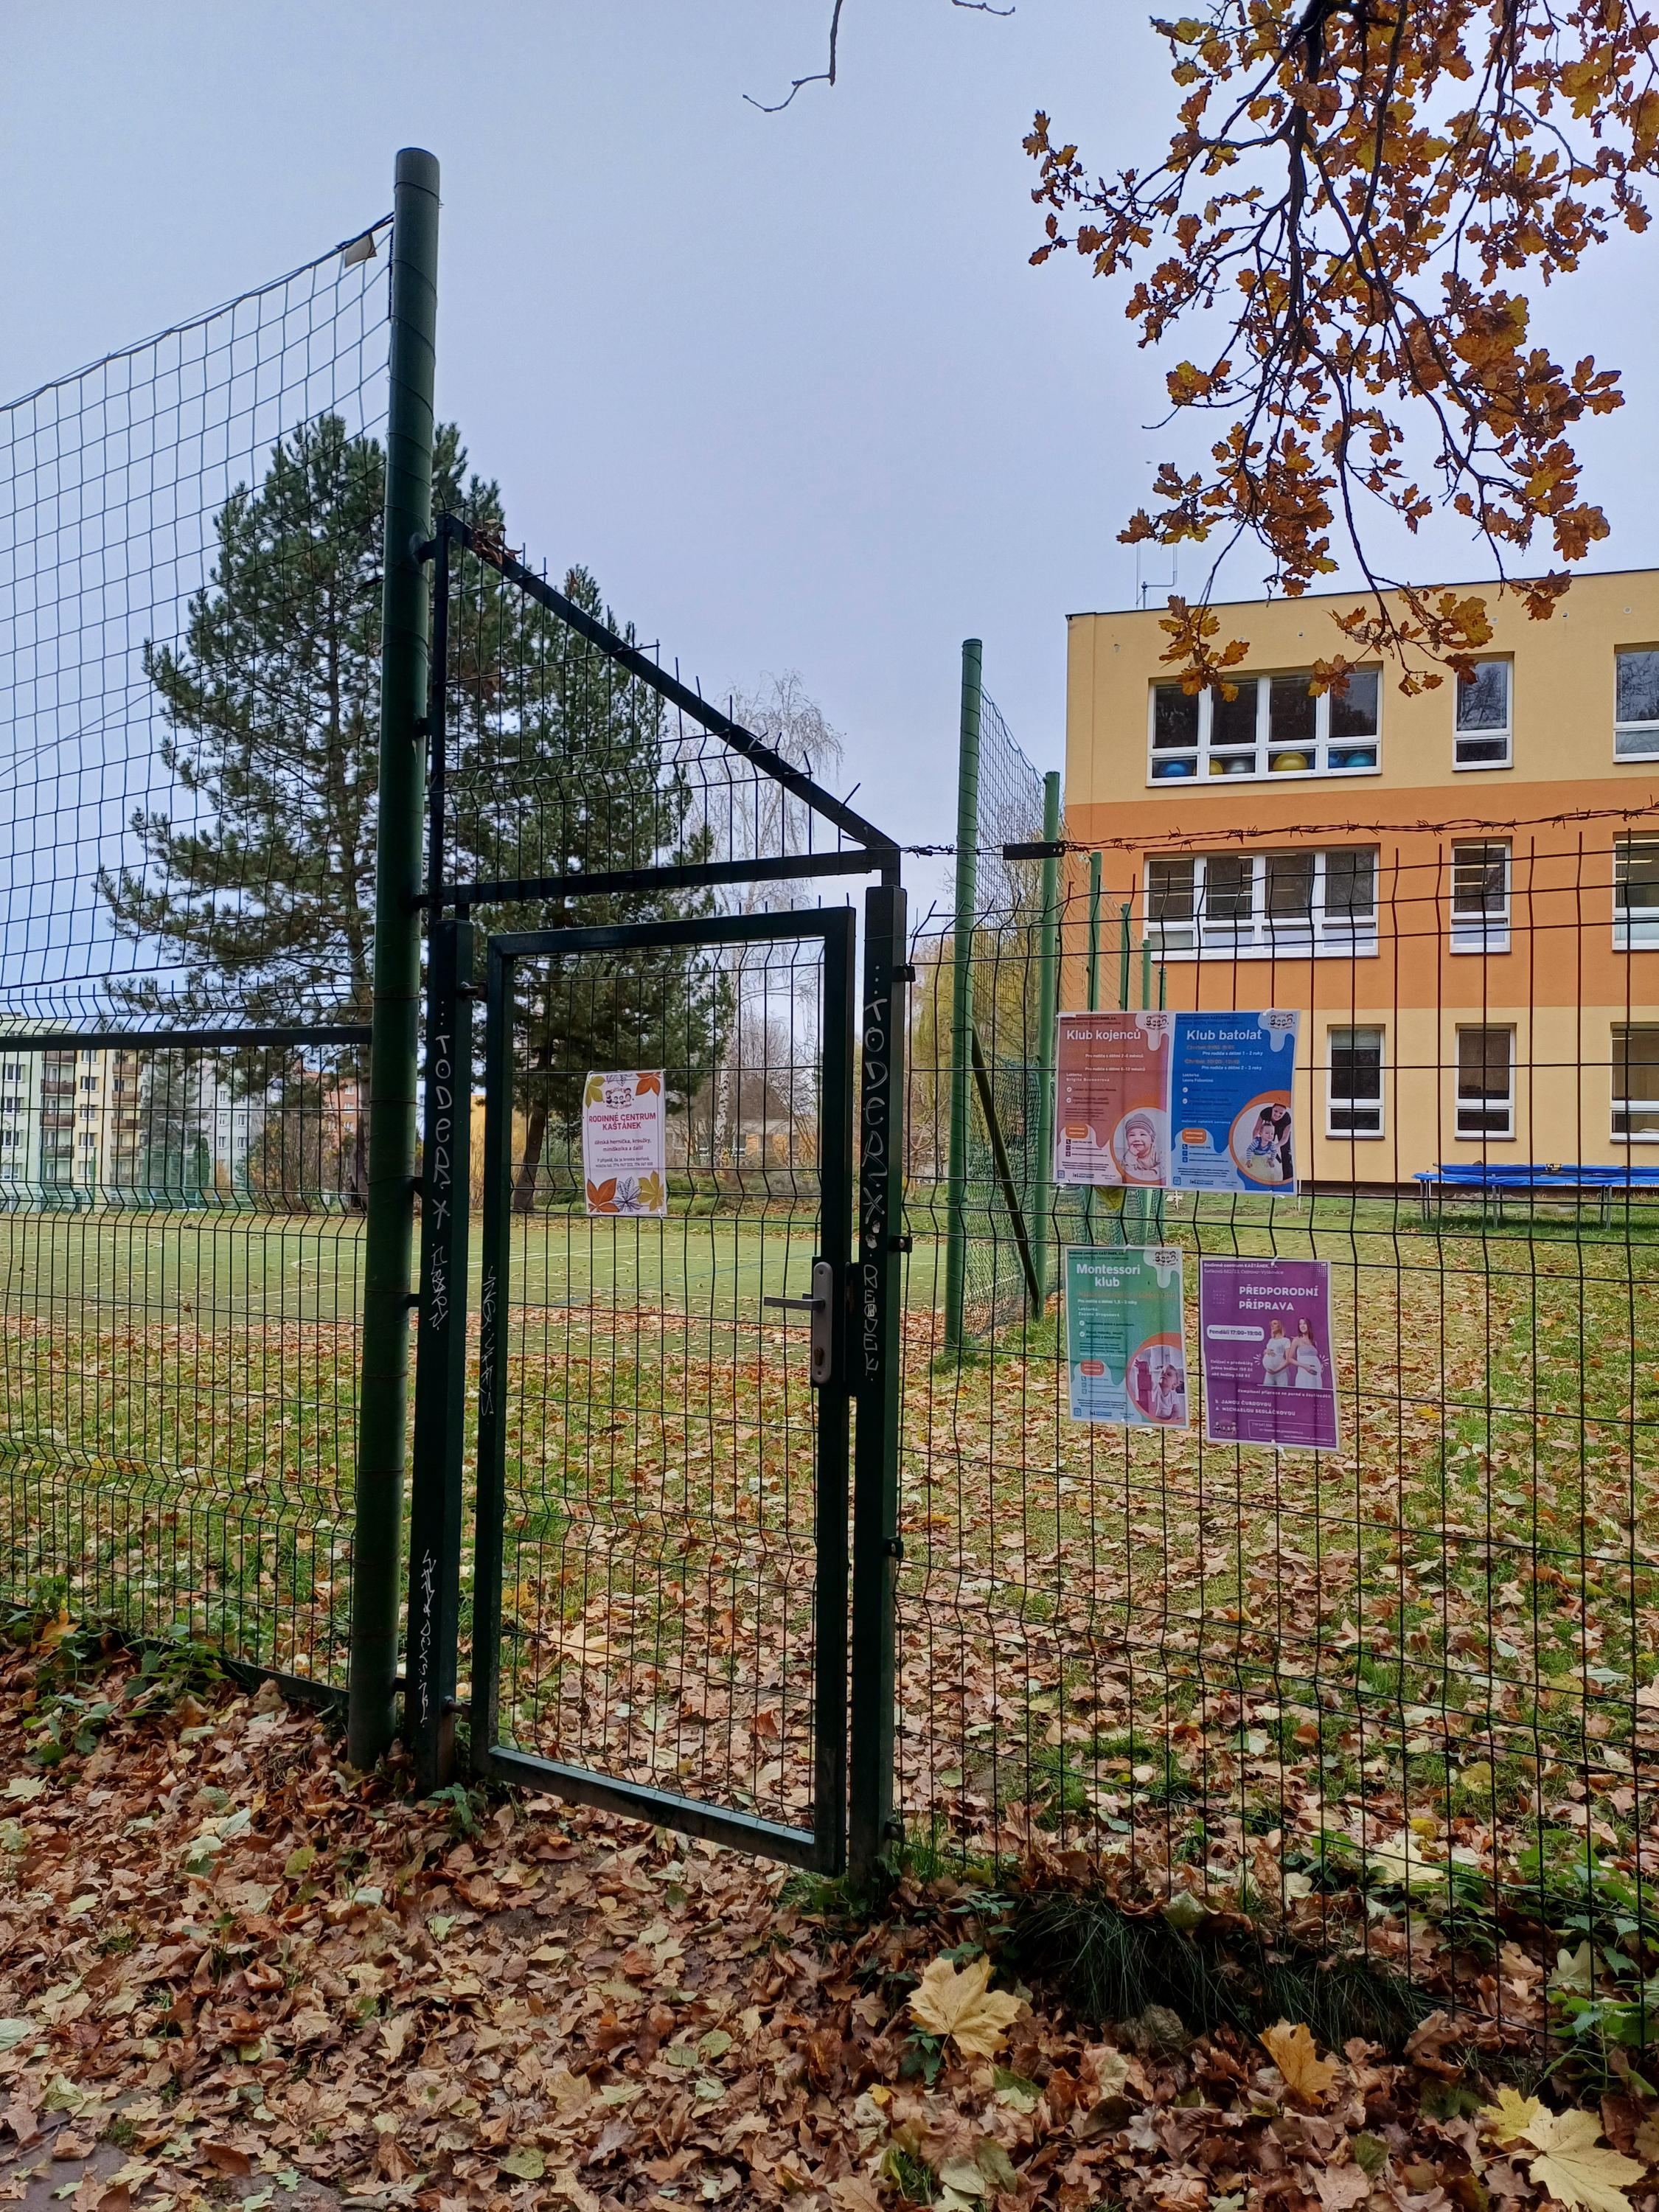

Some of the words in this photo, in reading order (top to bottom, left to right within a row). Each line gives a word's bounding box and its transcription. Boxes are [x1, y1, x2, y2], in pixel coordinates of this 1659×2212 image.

[1067, 1029, 1093, 1040] Klub
[1096, 1028, 1141, 1042] kojenců
[1186, 1030, 1215, 1040] Klub
[1219, 1029, 1262, 1040] batolat
[589, 1113, 619, 1123] RODINNÉ
[620, 1113, 656, 1121] CENTRUM
[602, 1121, 641, 1130] KAŠTÁNEK
[1077, 1264, 1141, 1275] Montessori
[1095, 1276, 1120, 1287] klub
[1239, 1284, 1319, 1296] PŘEDPORODNÍ
[1239, 1298, 1294, 1311] PŘÍPRAVA
